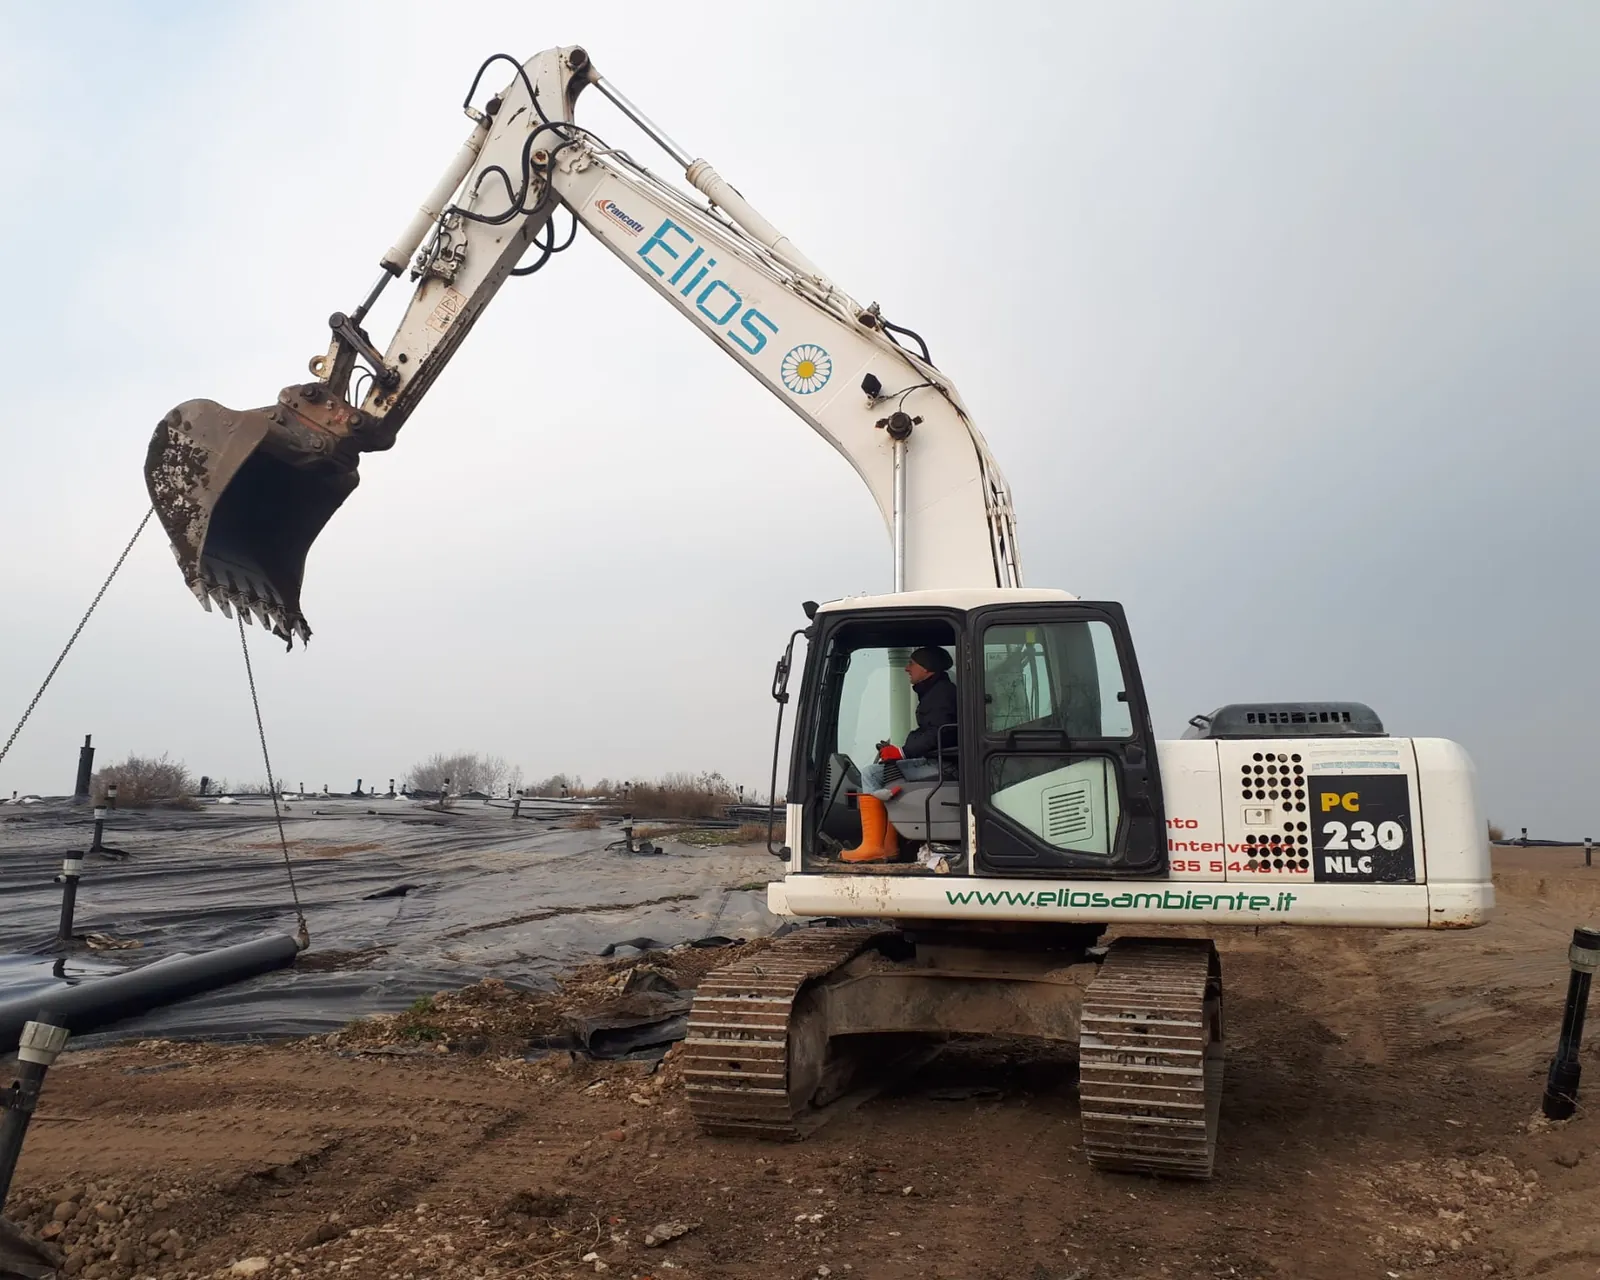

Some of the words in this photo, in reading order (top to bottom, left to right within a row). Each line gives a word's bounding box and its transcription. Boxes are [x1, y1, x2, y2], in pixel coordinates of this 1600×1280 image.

[606, 202, 645, 233] Pancotti
[637, 218, 779, 355] Elios
[1321, 792, 1360, 812] PC
[1323, 821, 1404, 851] 230
[1324, 855, 1373, 874] NLC
[945, 888, 1297, 912] www.eliosambiente.it
